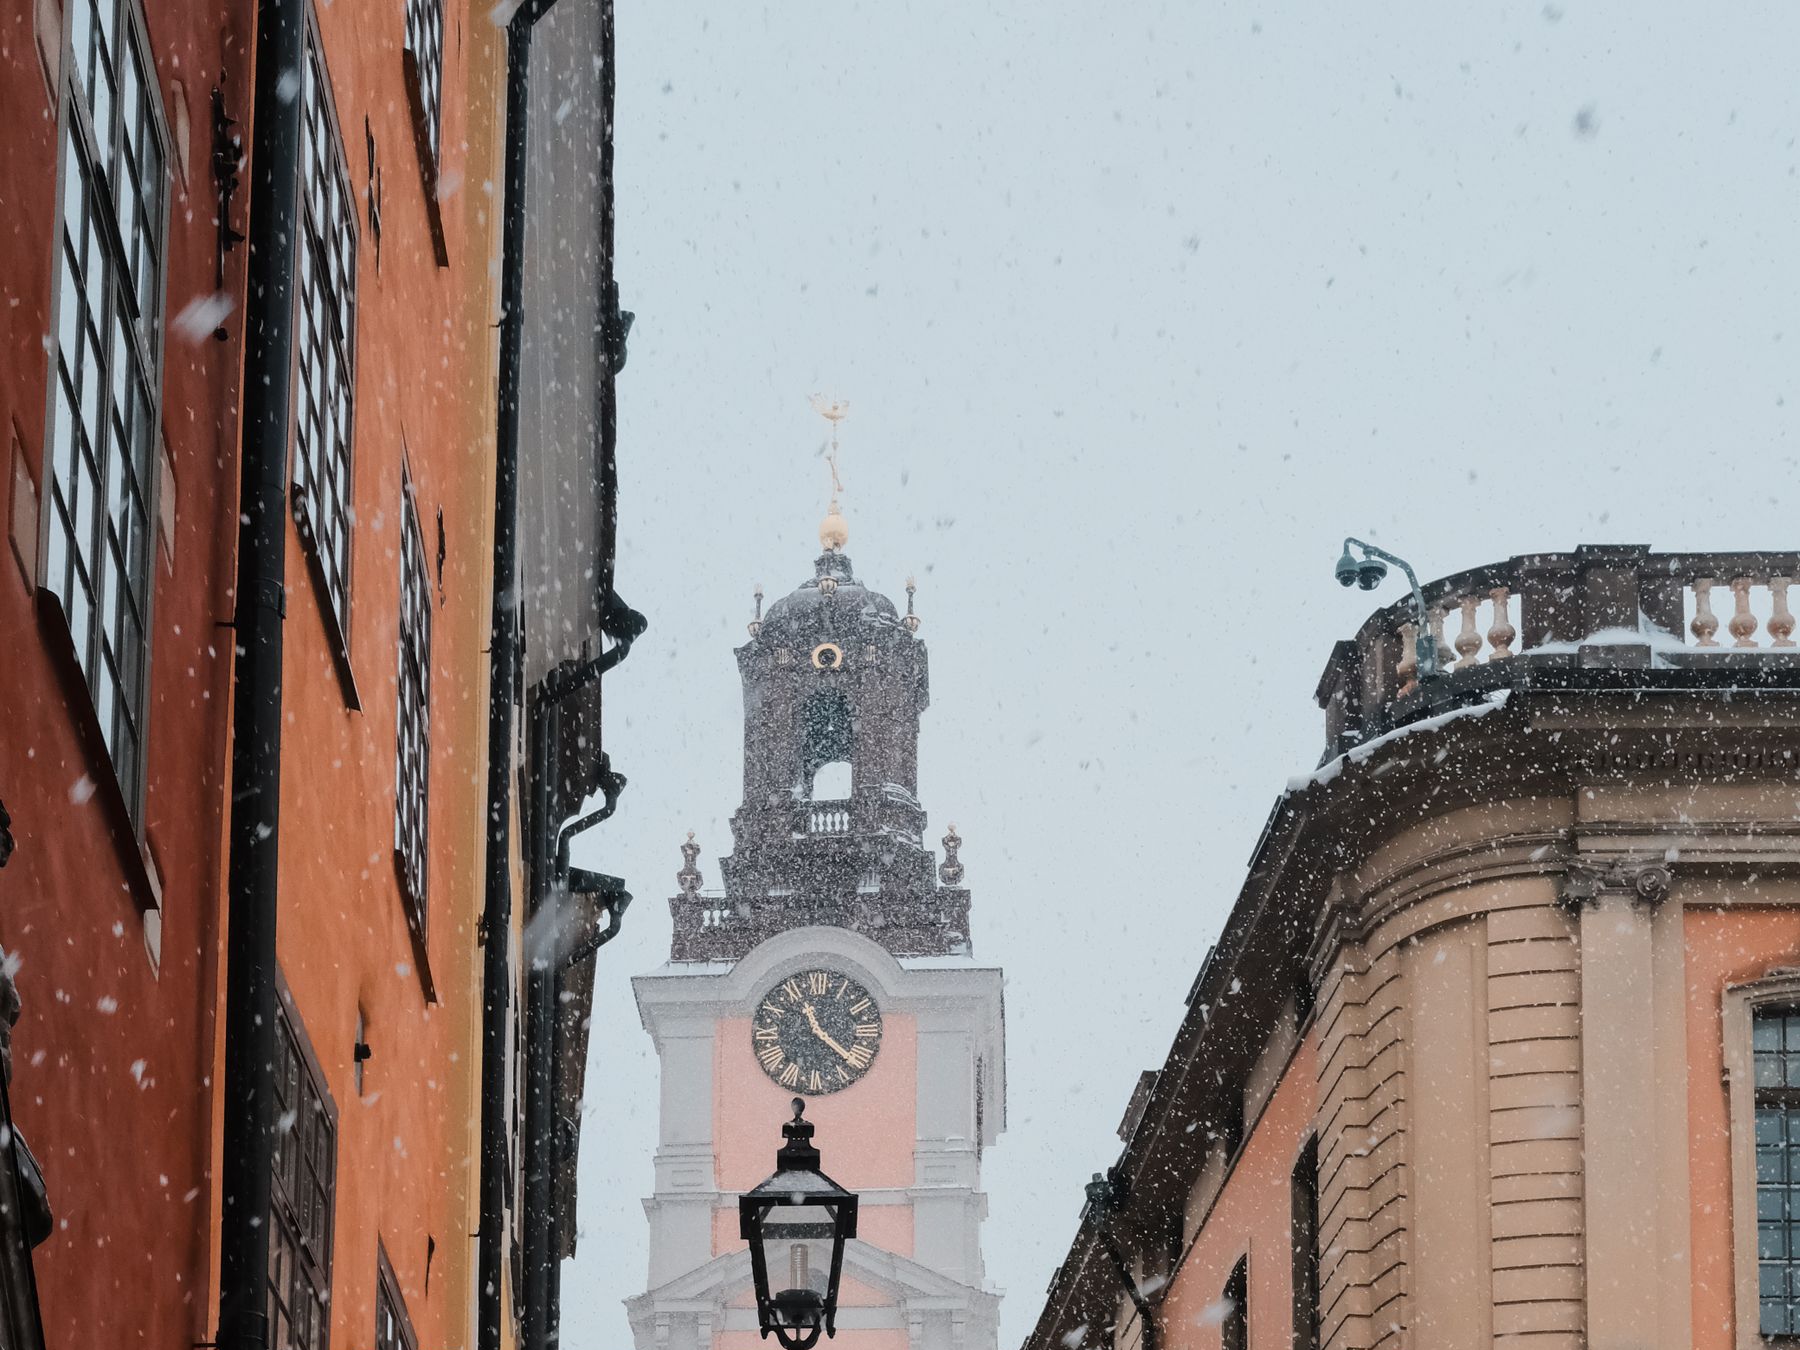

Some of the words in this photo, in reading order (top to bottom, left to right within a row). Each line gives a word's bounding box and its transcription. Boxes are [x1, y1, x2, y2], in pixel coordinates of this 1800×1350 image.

[783, 980, 802, 1003] XI
[809, 973, 827, 995] XII
[762, 1000, 785, 1018] X
[849, 998, 872, 1015] II
[856, 1024, 878, 1037] III
